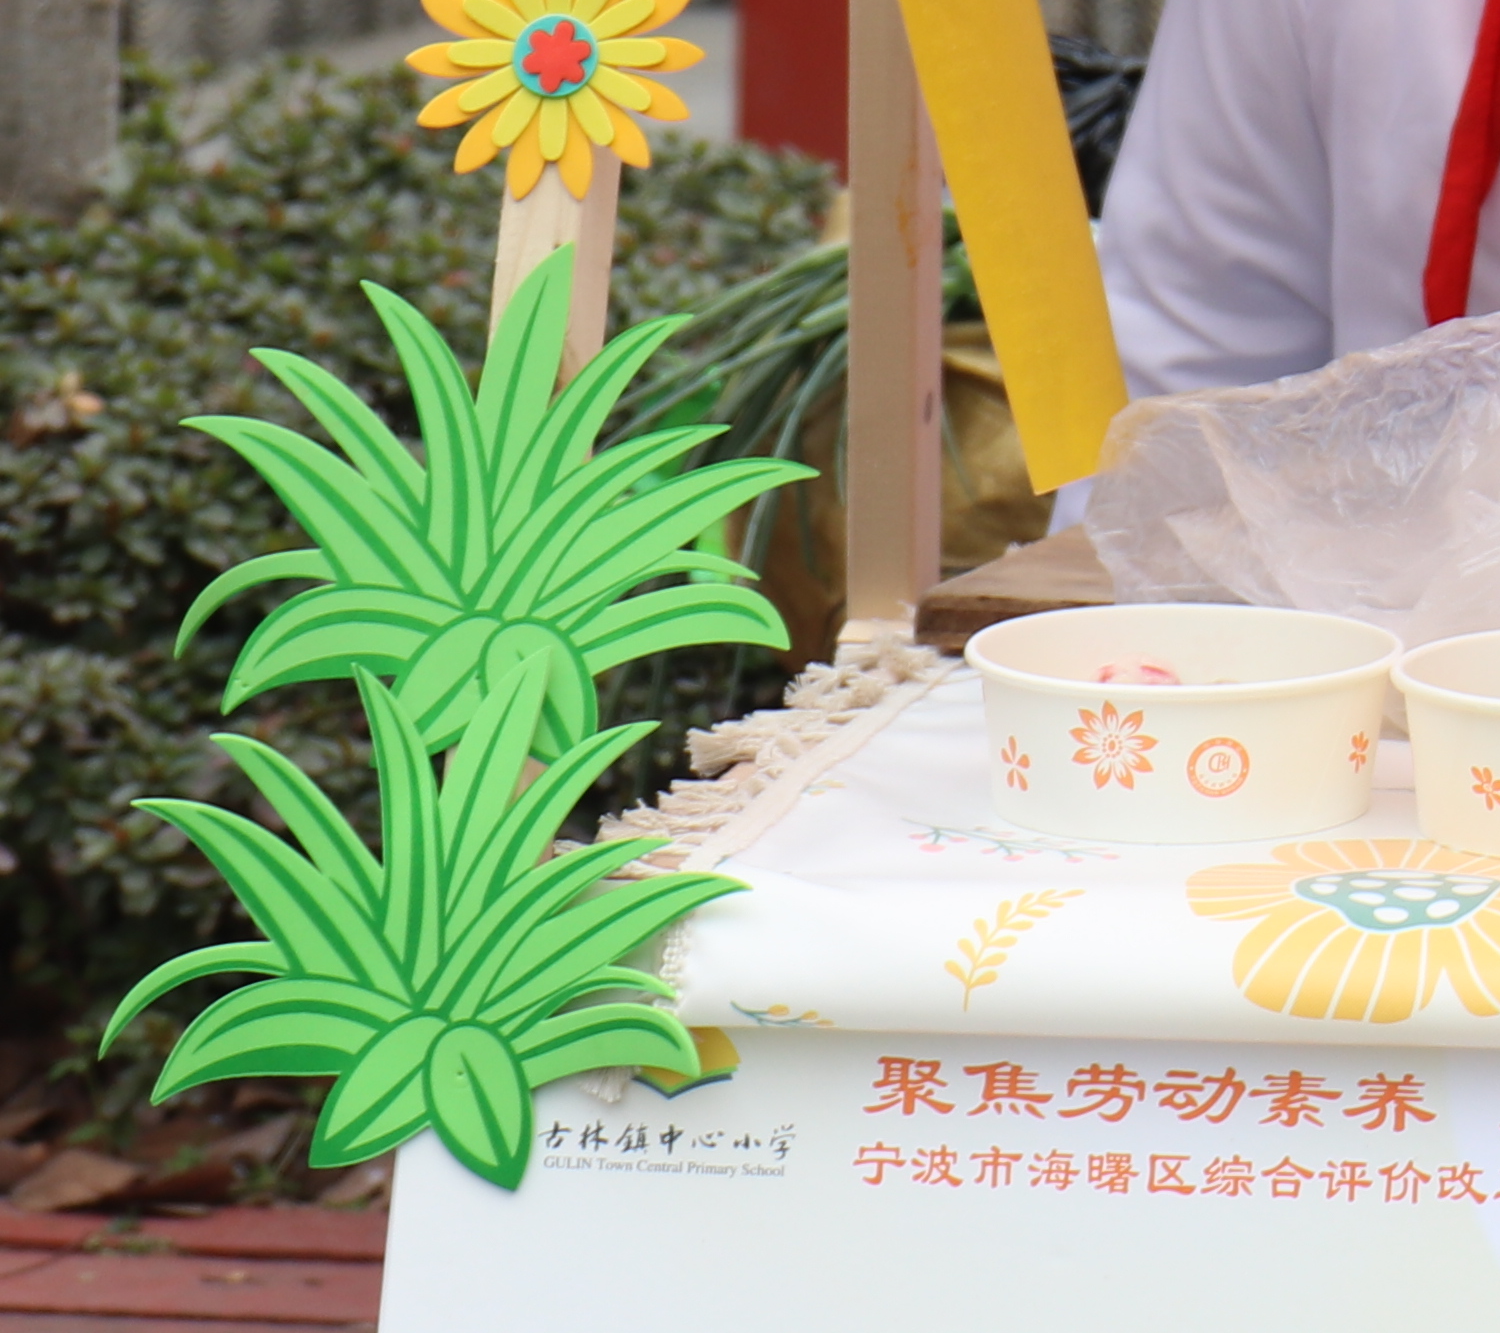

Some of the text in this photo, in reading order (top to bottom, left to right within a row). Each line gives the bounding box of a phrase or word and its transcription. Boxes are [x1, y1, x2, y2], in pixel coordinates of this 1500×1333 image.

[862, 1055, 1437, 1133] 聚焦劳动素养
[543, 1154, 786, 1179] GULIN Town Central Primary School
